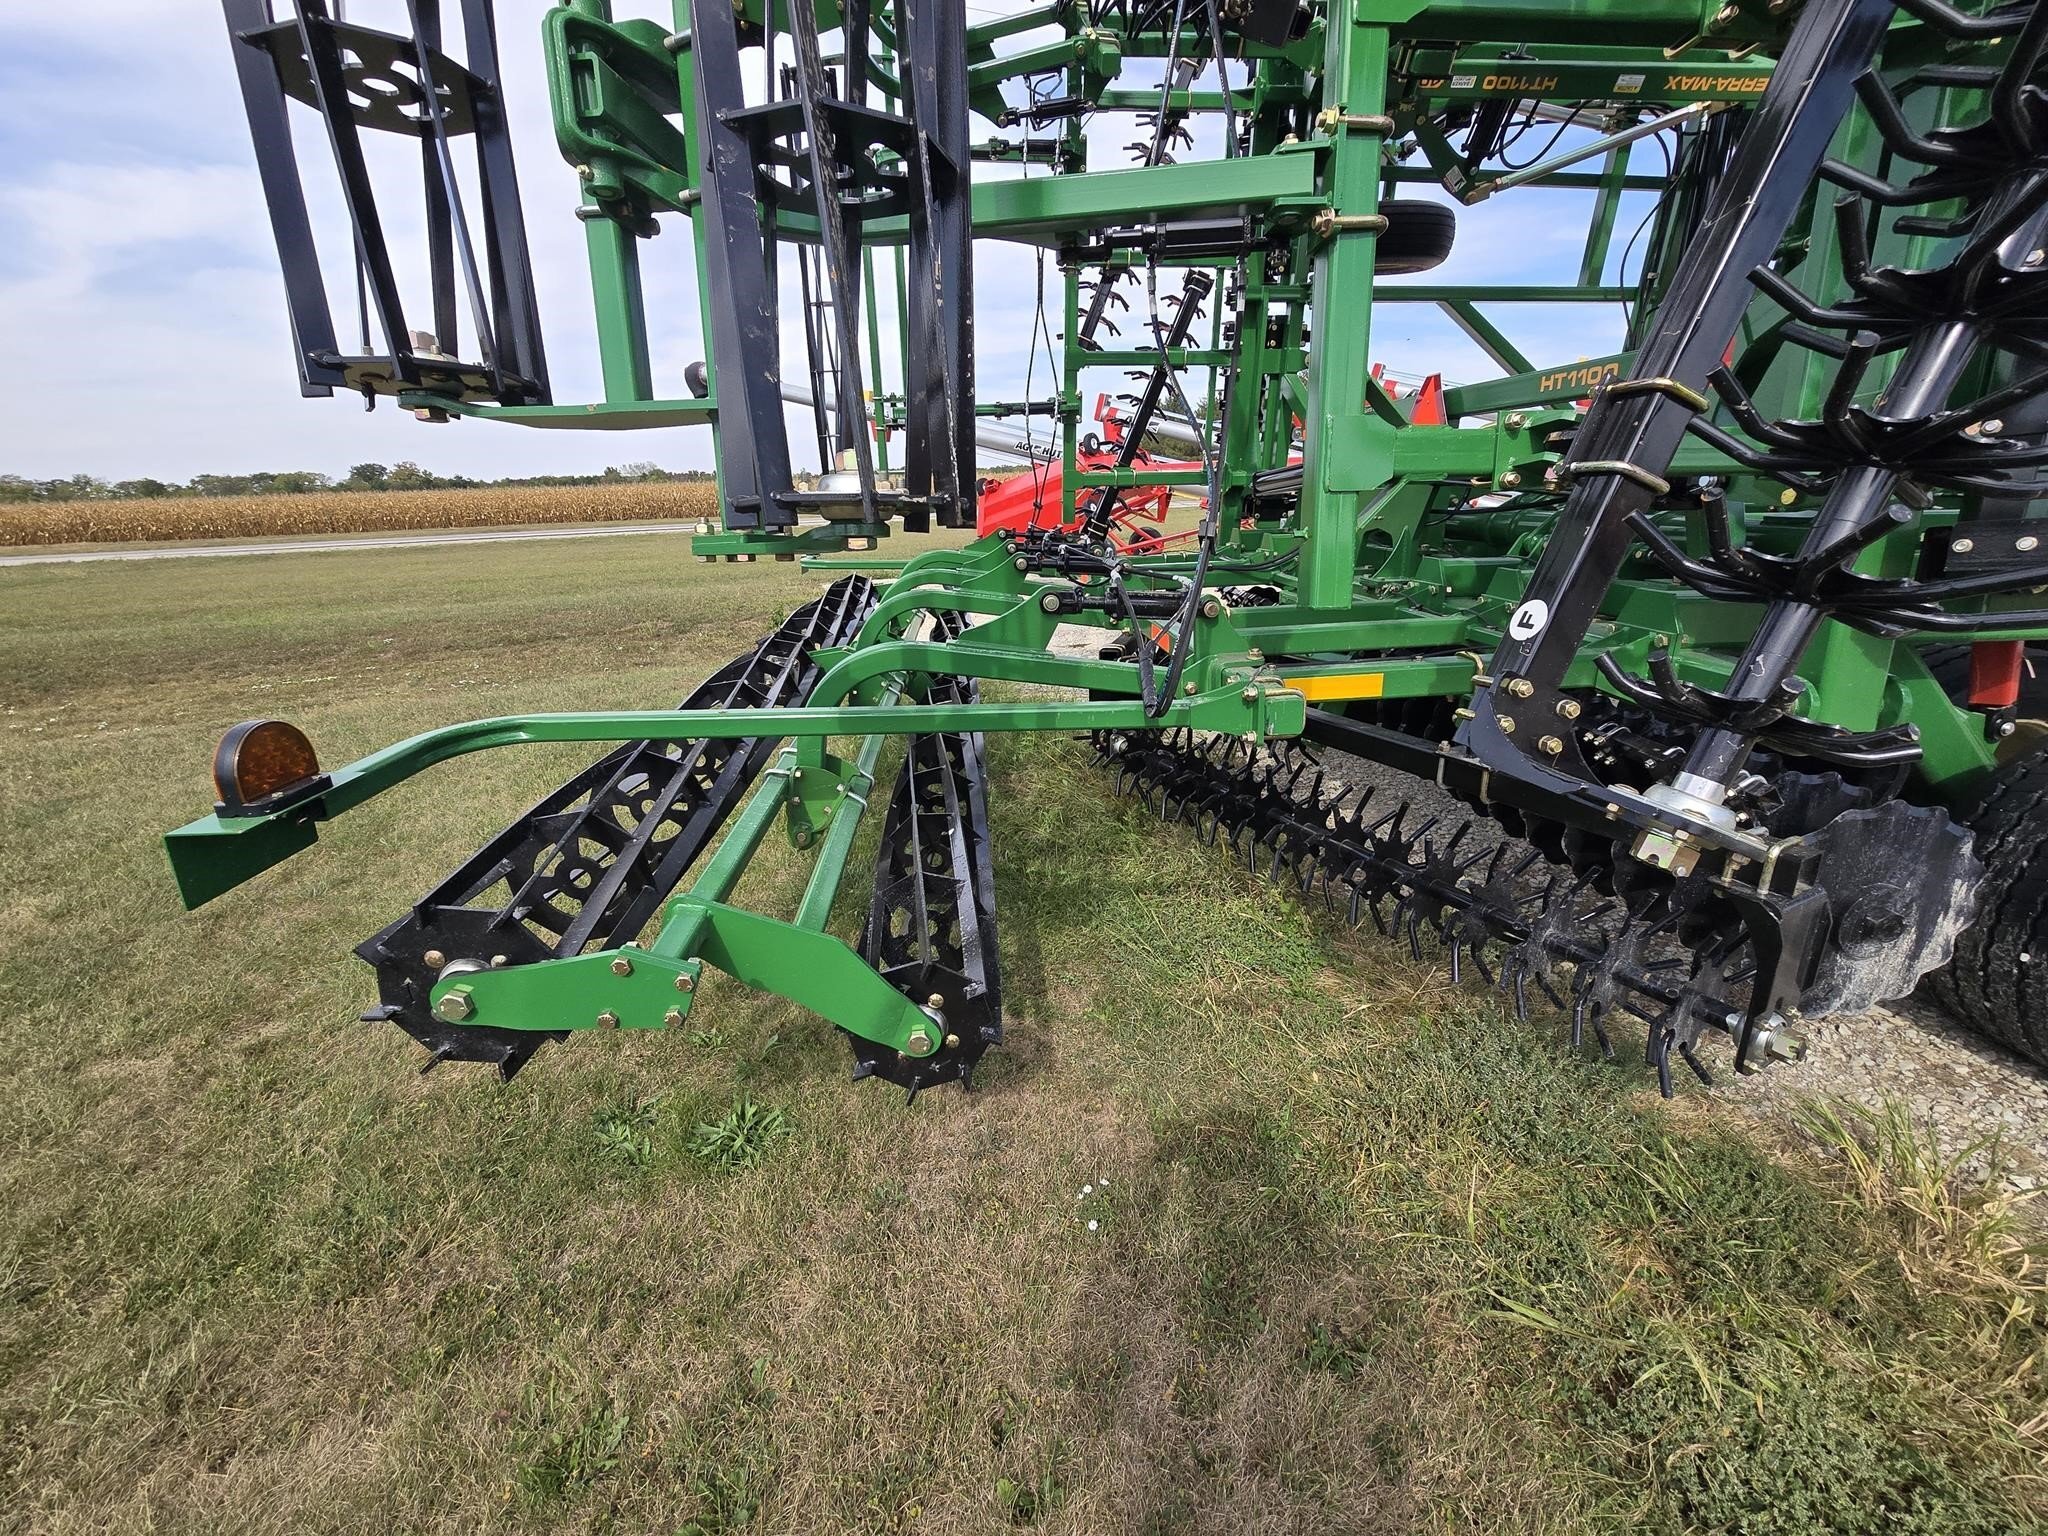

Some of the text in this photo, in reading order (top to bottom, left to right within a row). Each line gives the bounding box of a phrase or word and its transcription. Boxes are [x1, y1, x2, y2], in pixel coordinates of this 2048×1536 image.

[1482, 75, 1557, 90] HT1100
[1664, 75, 1770, 92] ERRA-MAX
[1042, 446, 1063, 458] HUT
[1517, 610, 1535, 630] F
